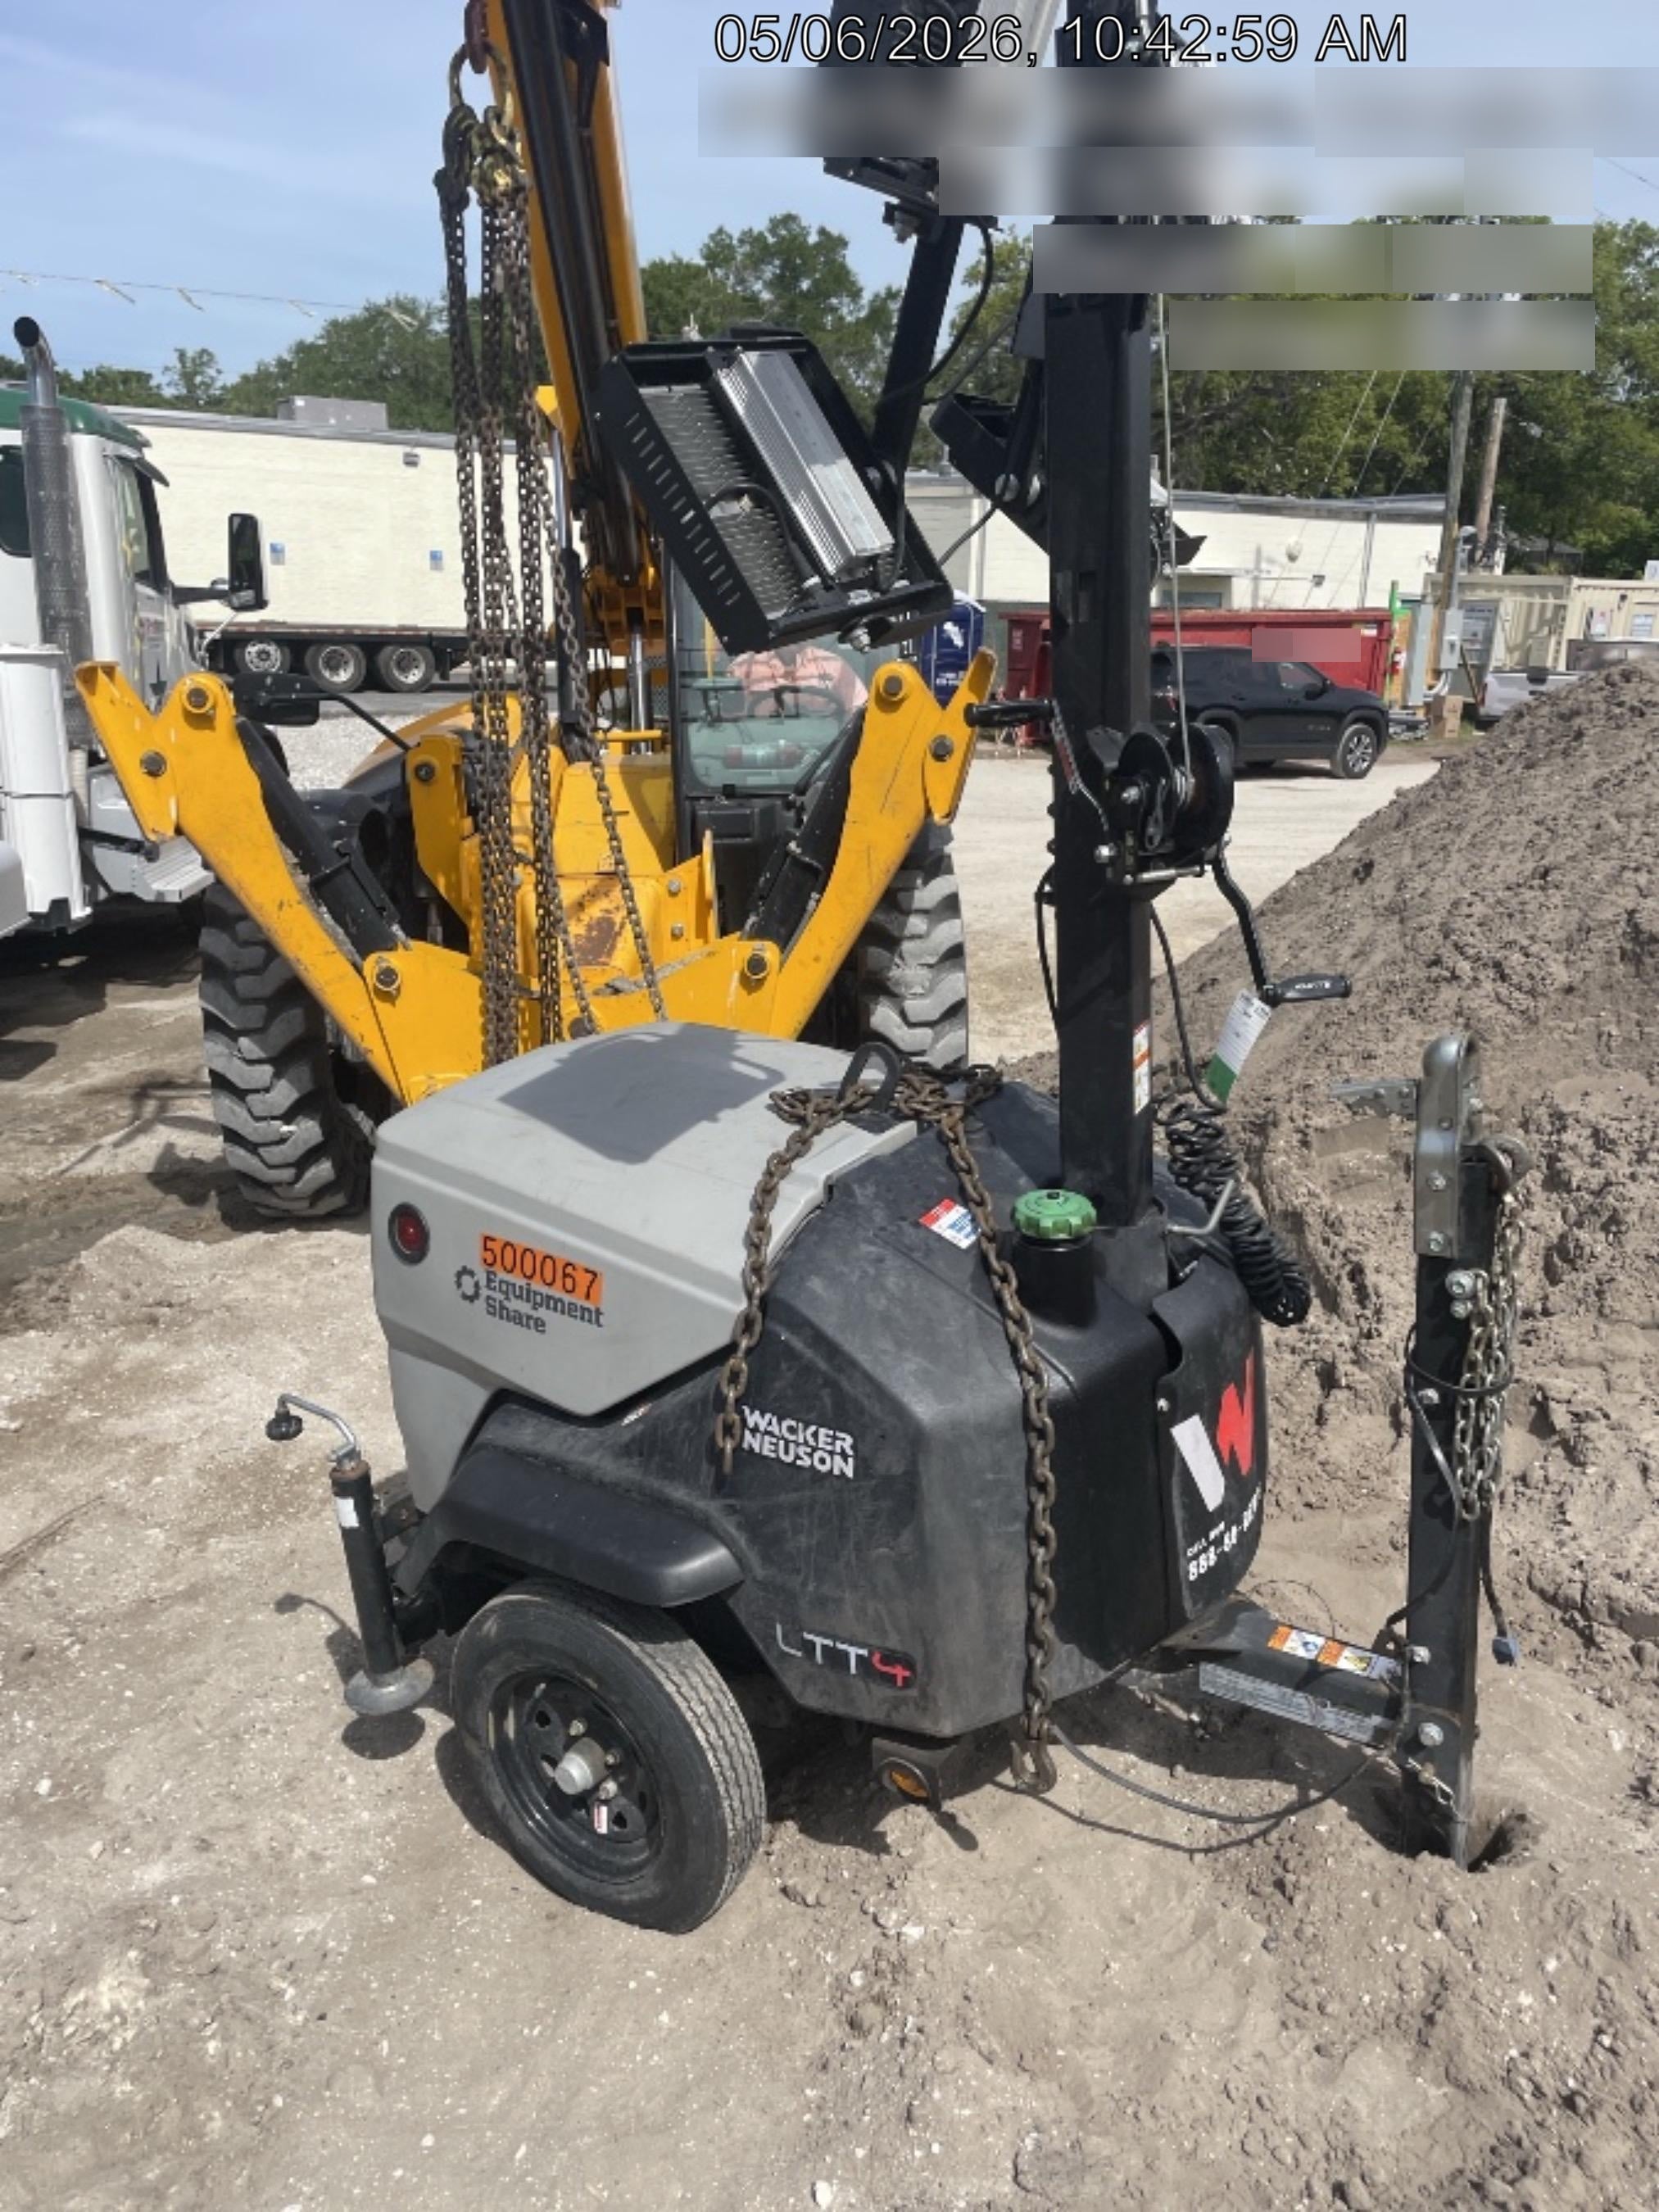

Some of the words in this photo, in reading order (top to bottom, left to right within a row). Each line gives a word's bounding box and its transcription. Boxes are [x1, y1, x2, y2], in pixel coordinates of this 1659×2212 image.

[483, 1235, 598, 1301] 500067
[485, 1270, 605, 1327] Equipment
[485, 1295, 546, 1334] Share
[741, 1405, 854, 1456] WACKER
[742, 1429, 854, 1480] NEUSON
[776, 1623, 912, 1687] LTT4
